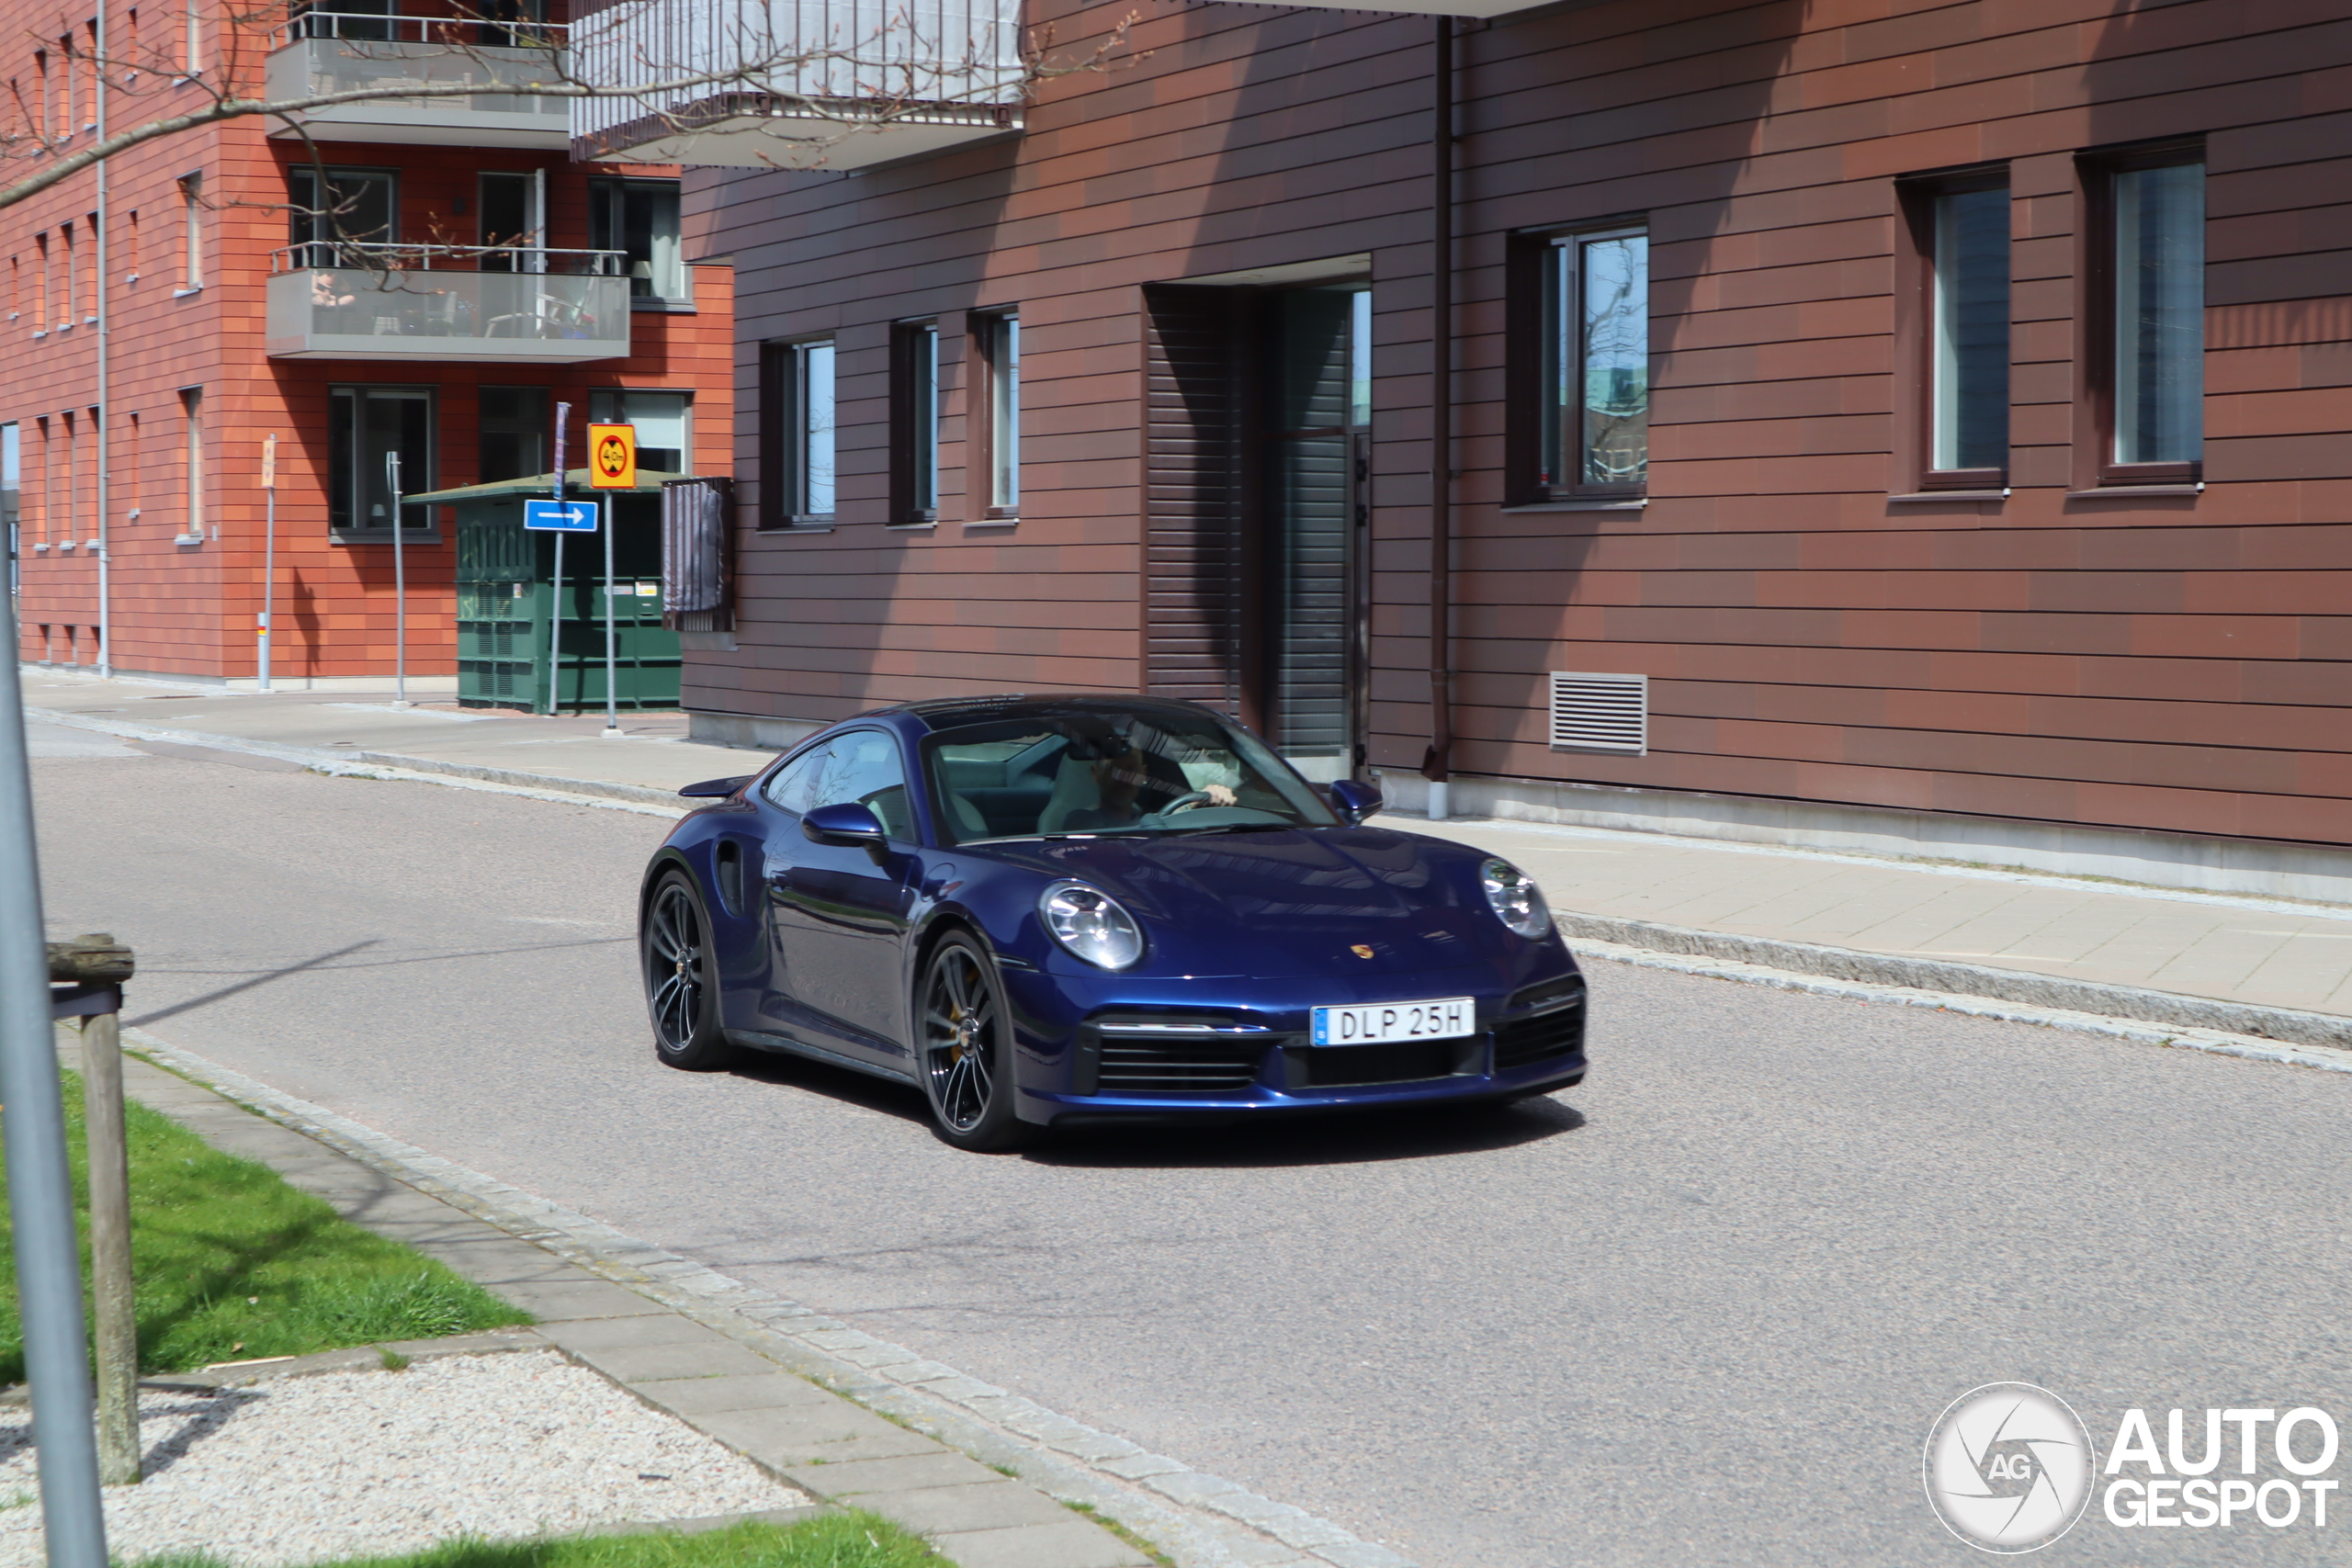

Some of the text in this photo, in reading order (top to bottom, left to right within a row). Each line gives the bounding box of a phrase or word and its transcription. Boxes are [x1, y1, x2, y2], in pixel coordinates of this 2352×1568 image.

[1341, 1004, 1462, 1040] DLP 25H
[1317, 1031, 1326, 1040] S
